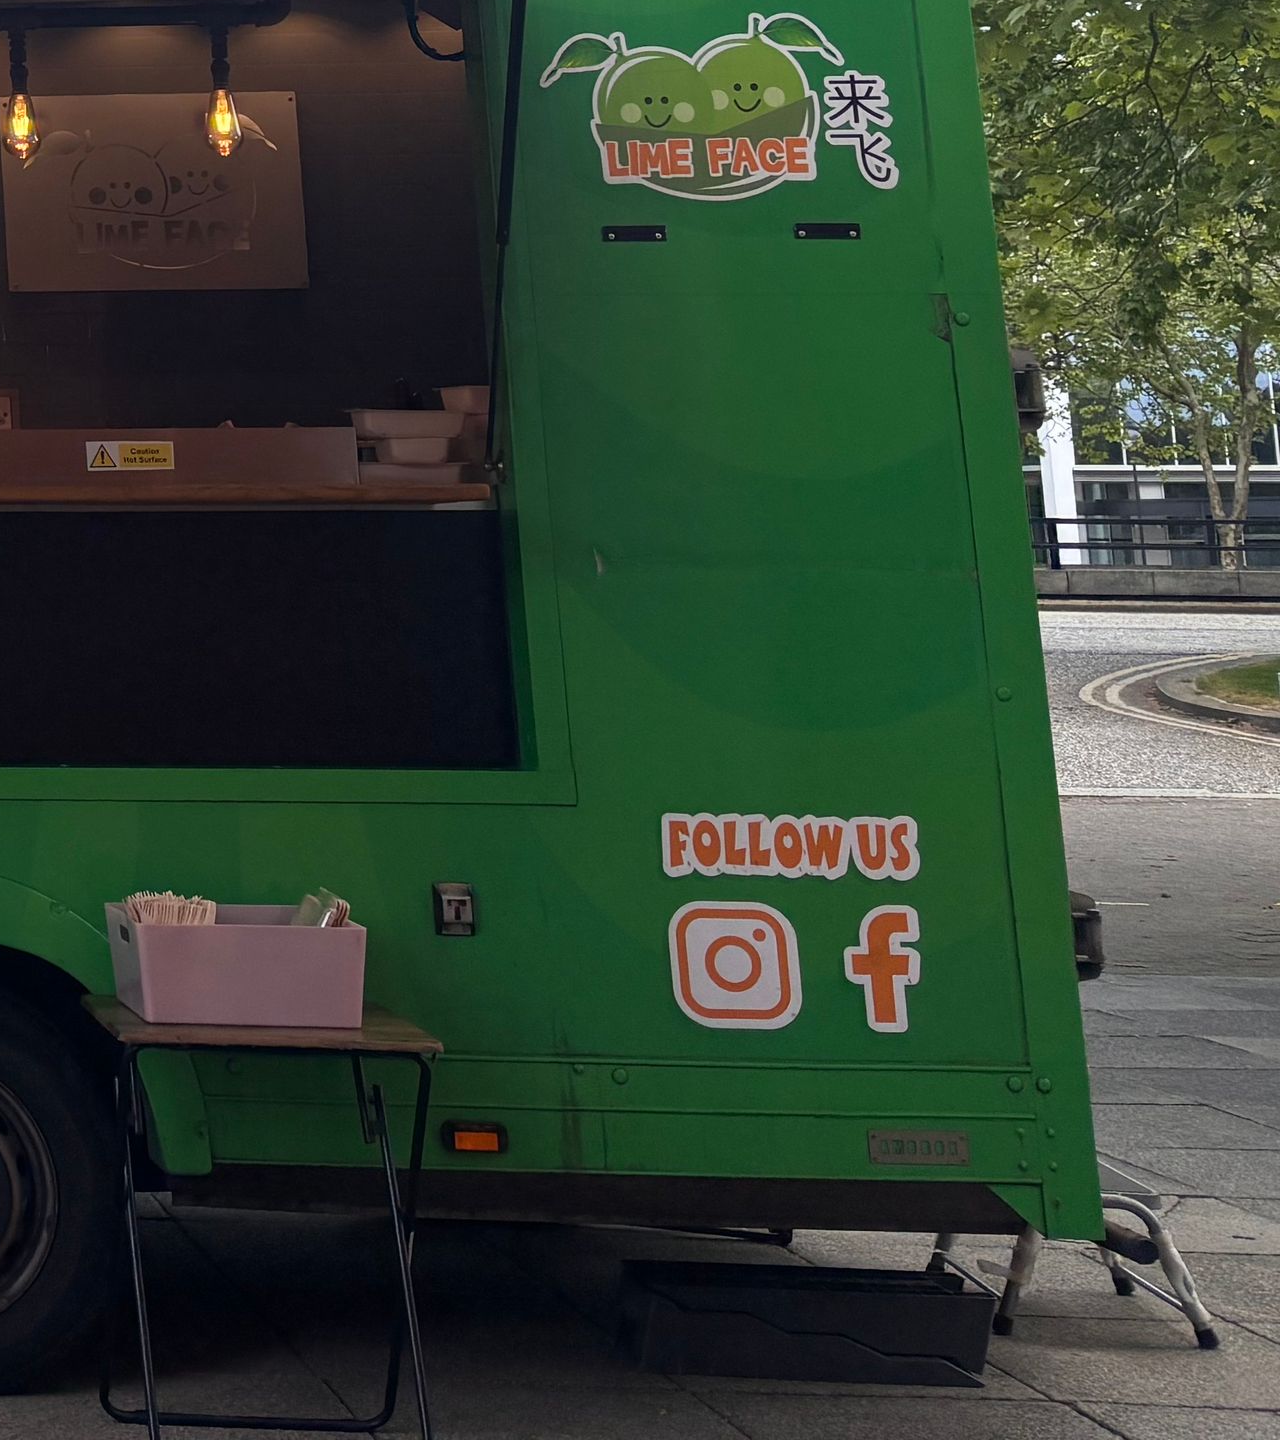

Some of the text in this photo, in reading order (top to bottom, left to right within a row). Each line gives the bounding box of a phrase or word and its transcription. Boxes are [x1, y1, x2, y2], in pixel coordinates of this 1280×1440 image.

[826, 72, 893, 185] 来飞
[604, 136, 811, 178] LIME FACE
[668, 820, 911, 872] FOLLOW US
